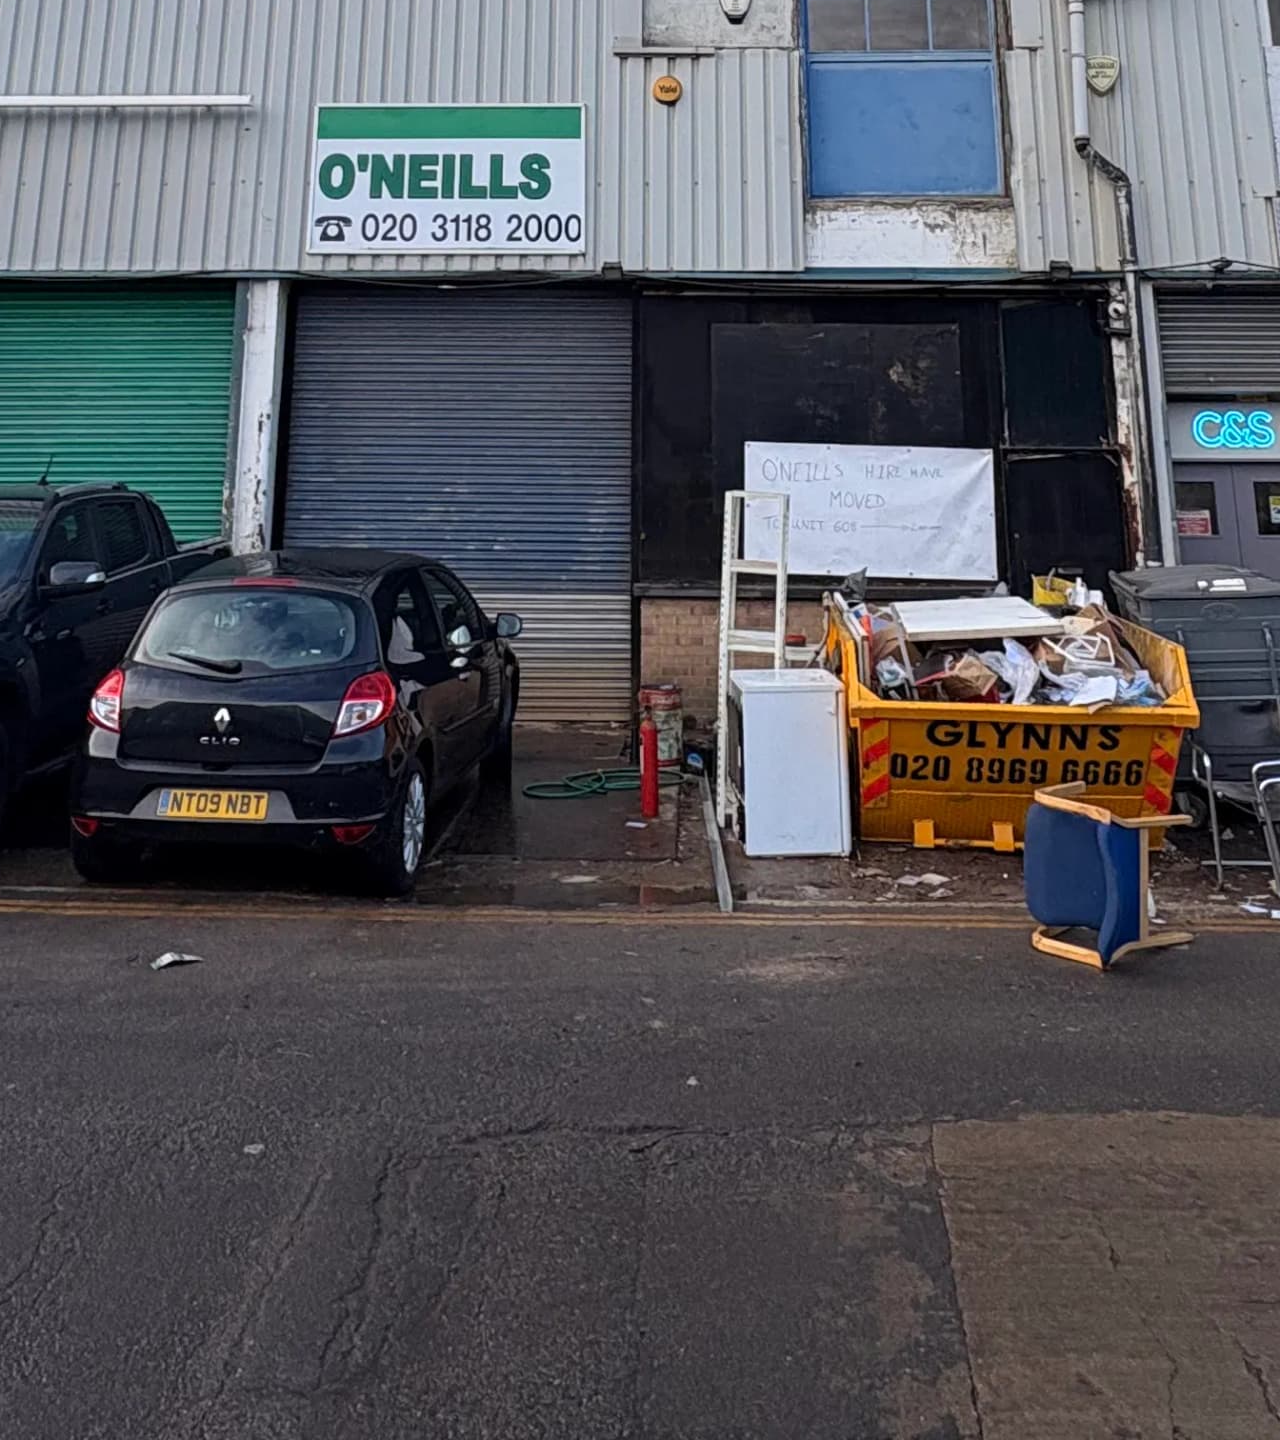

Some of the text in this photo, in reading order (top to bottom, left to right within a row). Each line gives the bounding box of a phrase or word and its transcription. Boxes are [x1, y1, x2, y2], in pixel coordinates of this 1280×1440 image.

[318, 152, 552, 200] O'NEILLS
[361, 213, 582, 243] 020 3118 2000
[1192, 410, 1276, 449] C&S
[865, 464, 902, 479] HIRE
[909, 466, 945, 479] HAVE
[829, 490, 887, 510] MOVED
[199, 736, 241, 746] CLIO
[926, 719, 1122, 752] GLYNNS
[890, 752, 1145, 787] 020 8969 6666
[170, 791, 266, 815] NT09 NBT
